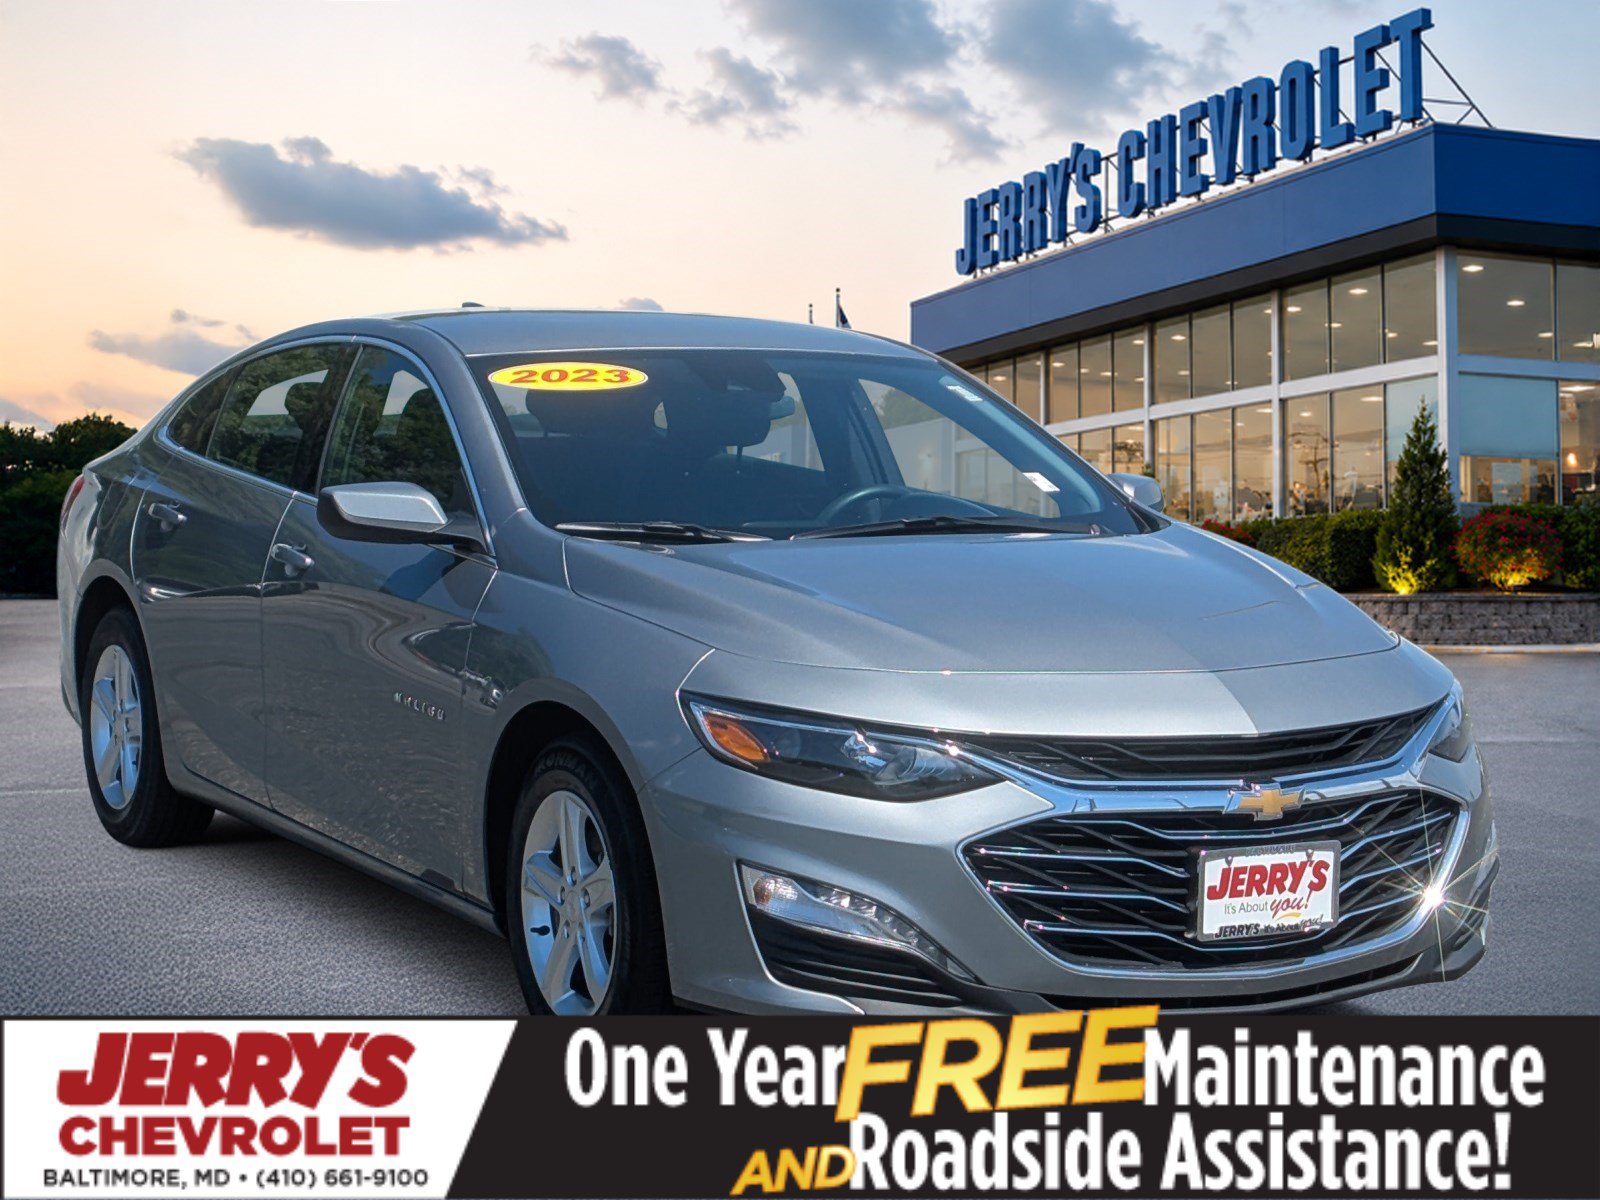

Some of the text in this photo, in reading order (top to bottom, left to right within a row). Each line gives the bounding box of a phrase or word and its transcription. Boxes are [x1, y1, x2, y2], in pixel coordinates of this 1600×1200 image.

[956, 8, 1434, 275] JERRY'S CHEVROLET
[510, 369, 630, 383] 2023
[1206, 860, 1330, 900] JERRY'S
[1224, 889, 1312, 919] It's About you!
[1214, 923, 1261, 938] JERRY'S
